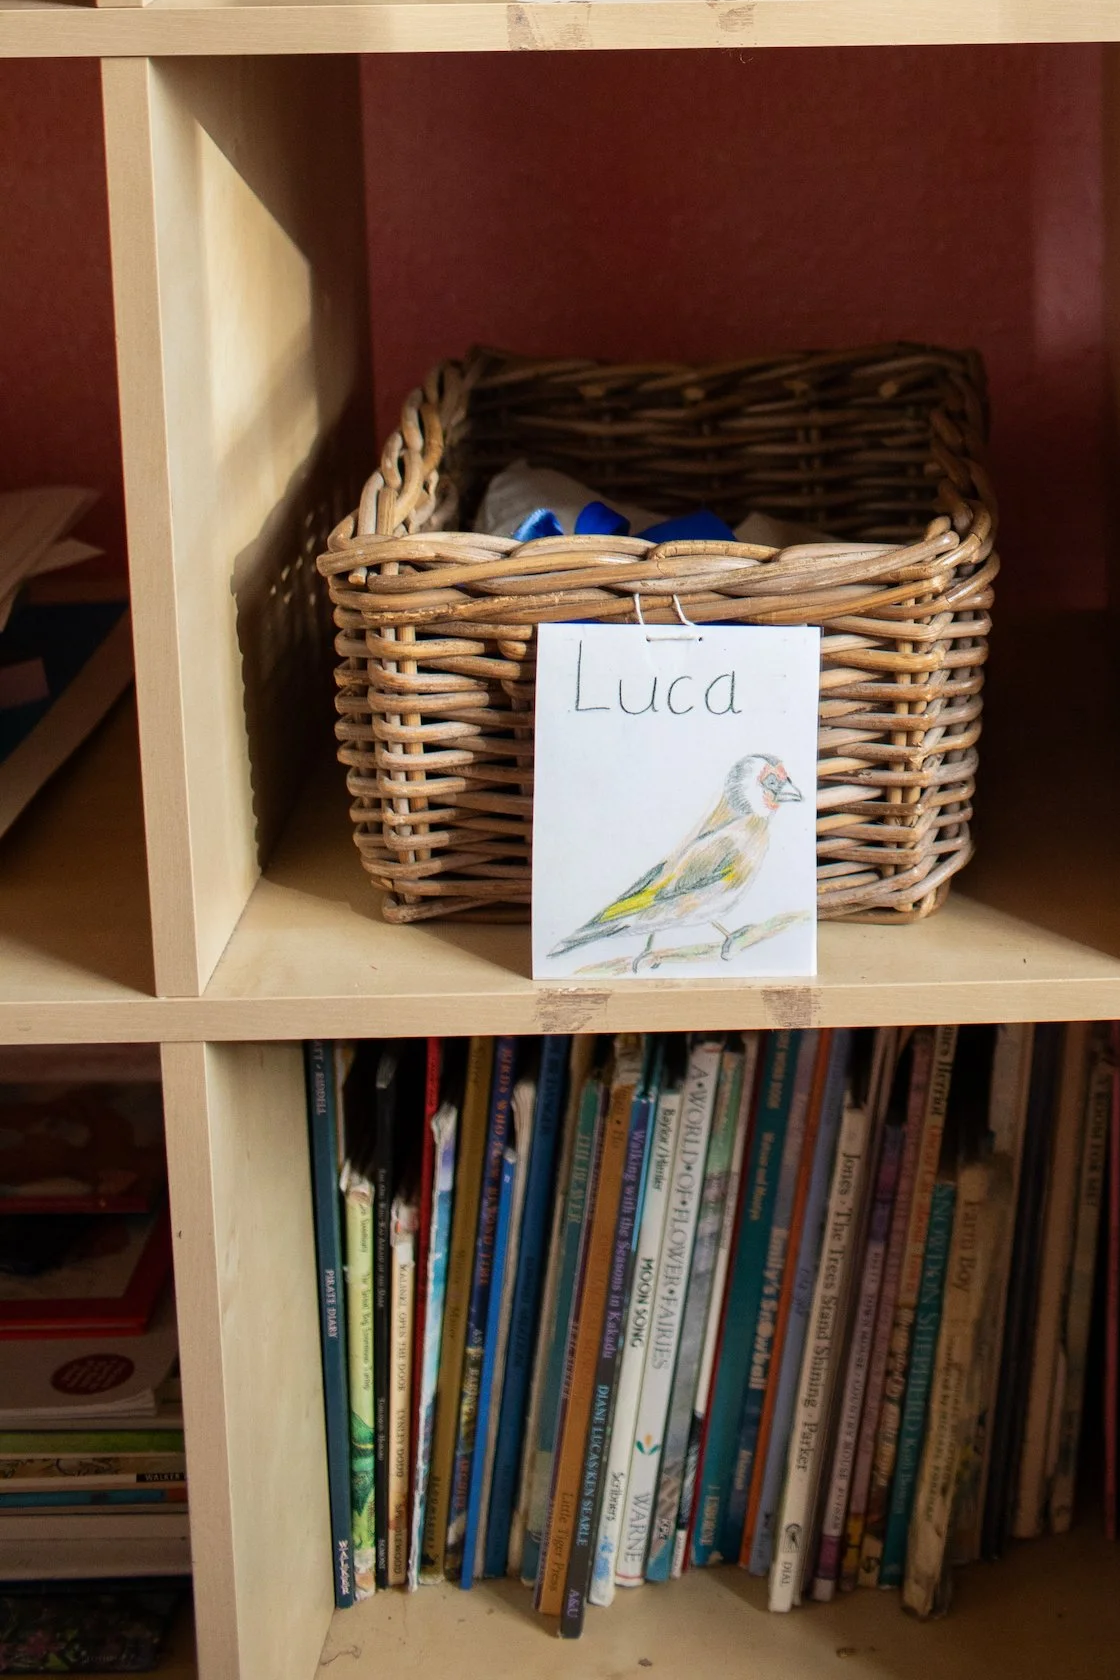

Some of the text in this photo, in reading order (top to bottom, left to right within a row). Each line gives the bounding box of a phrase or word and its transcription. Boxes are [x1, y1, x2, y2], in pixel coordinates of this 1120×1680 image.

[575, 639, 743, 715] Luca
[499, 1048, 513, 1093] BIRDS
[602, 1130, 645, 1359] Walking with the Seasons in Kakadu
[952, 1256, 977, 1294] Boy
[325, 1269, 339, 1339] PIRATE DIARY
[397, 1312, 407, 1338] OPEN
[630, 1258, 656, 1348] MOON SONG
[748, 1227, 789, 1390] Emily's Snowball
[796, 1152, 861, 1473] Jones The Trees Stand Shining Parker
[397, 1342, 407, 1360] THE
[651, 1296, 679, 1371] FAIRIES
[397, 1364, 407, 1392] DOOR
[902, 1312, 939, 1431] SHEPHERD
[594, 1384, 610, 1425] DIANE
[145, 1473, 181, 1481] WALKER
[839, 1440, 853, 1480] MOUSE
[606, 1472, 625, 1522] Scribners
[549, 1492, 574, 1592] Little Tiger Press
[576, 1500, 593, 1546] SEARLE
[623, 1492, 652, 1563] WARNE
[780, 1561, 791, 1587] DIAL
[567, 1588, 580, 1618] A&U
